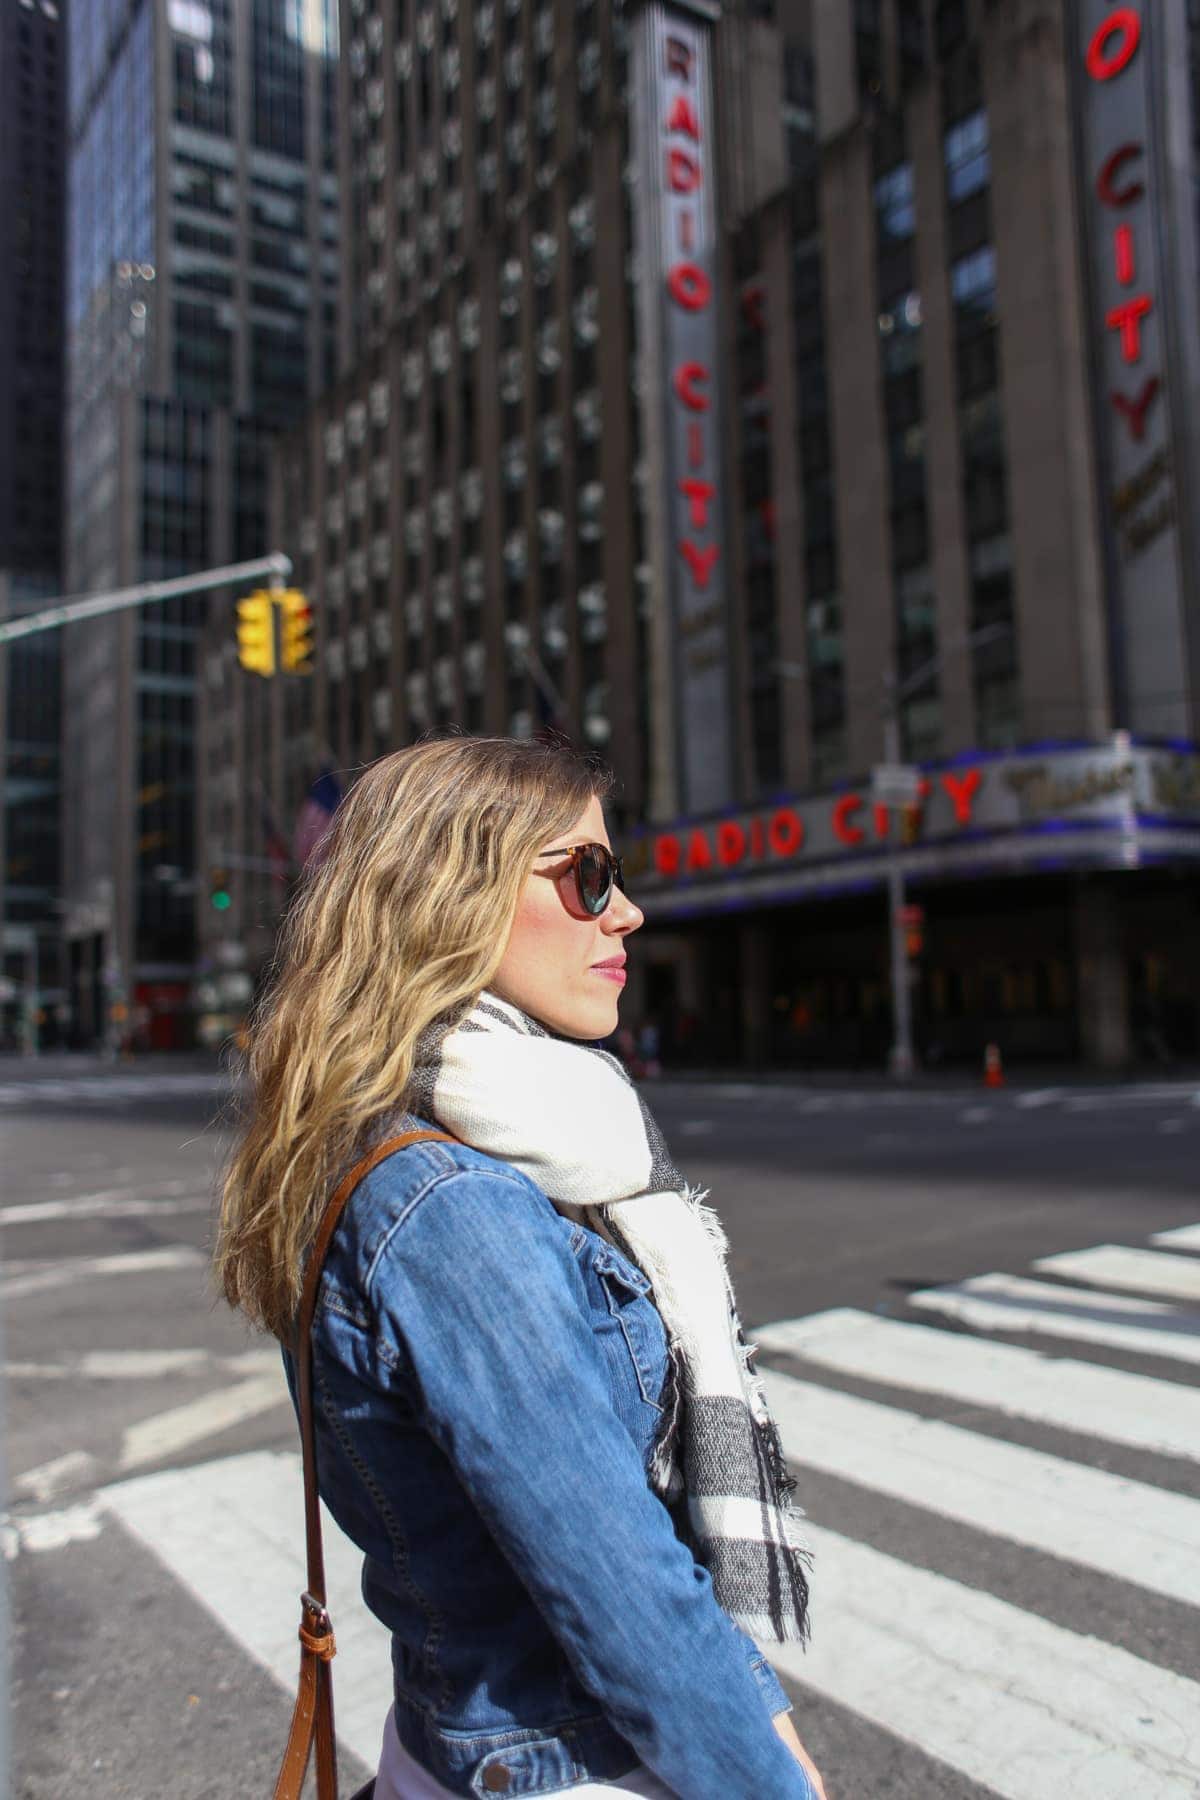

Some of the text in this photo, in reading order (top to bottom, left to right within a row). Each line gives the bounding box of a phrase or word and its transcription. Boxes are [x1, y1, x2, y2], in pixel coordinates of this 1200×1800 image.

[666, 36, 712, 312] RADIO
[1096, 141, 1160, 443] CITY
[673, 360, 720, 590] CITY
[654, 806, 802, 878] RADIO
